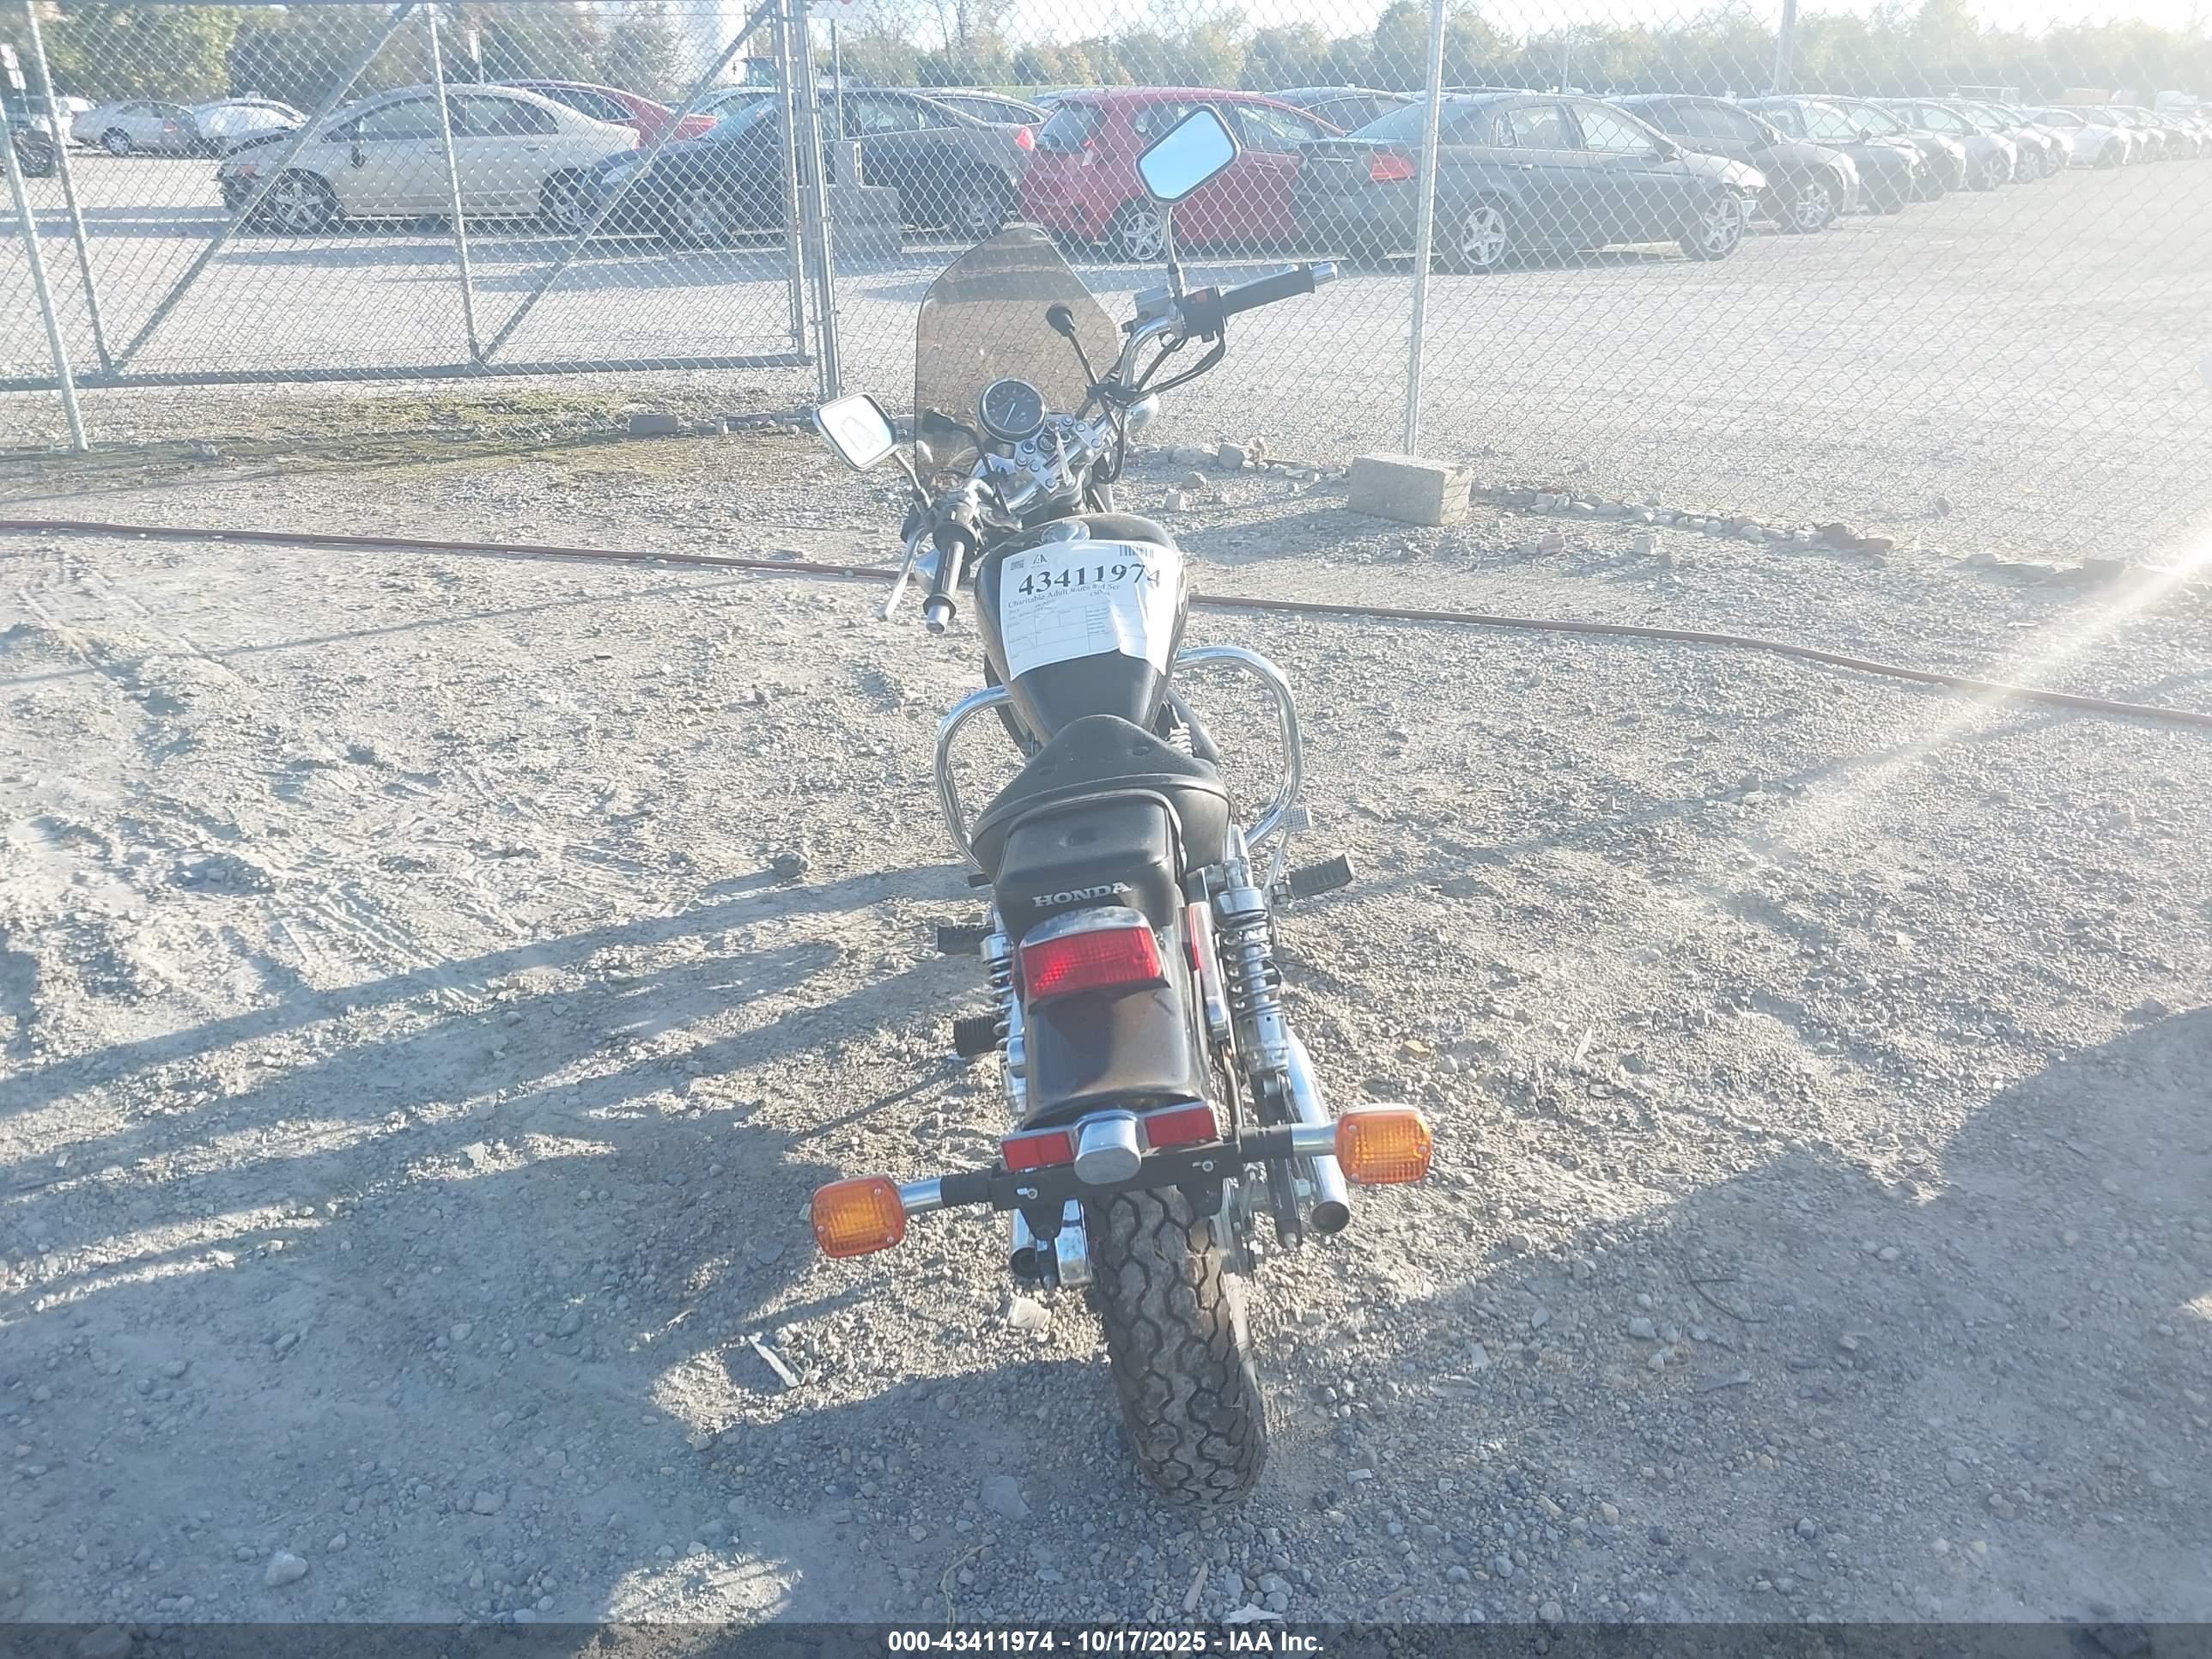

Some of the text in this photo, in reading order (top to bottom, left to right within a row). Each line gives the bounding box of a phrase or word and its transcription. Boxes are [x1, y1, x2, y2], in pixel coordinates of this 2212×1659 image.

[1018, 562, 1160, 595] 43411974
[1008, 594, 1045, 608] Charitable
[1048, 588, 1067, 599] Adult
[1032, 882, 1133, 907] HONDA
